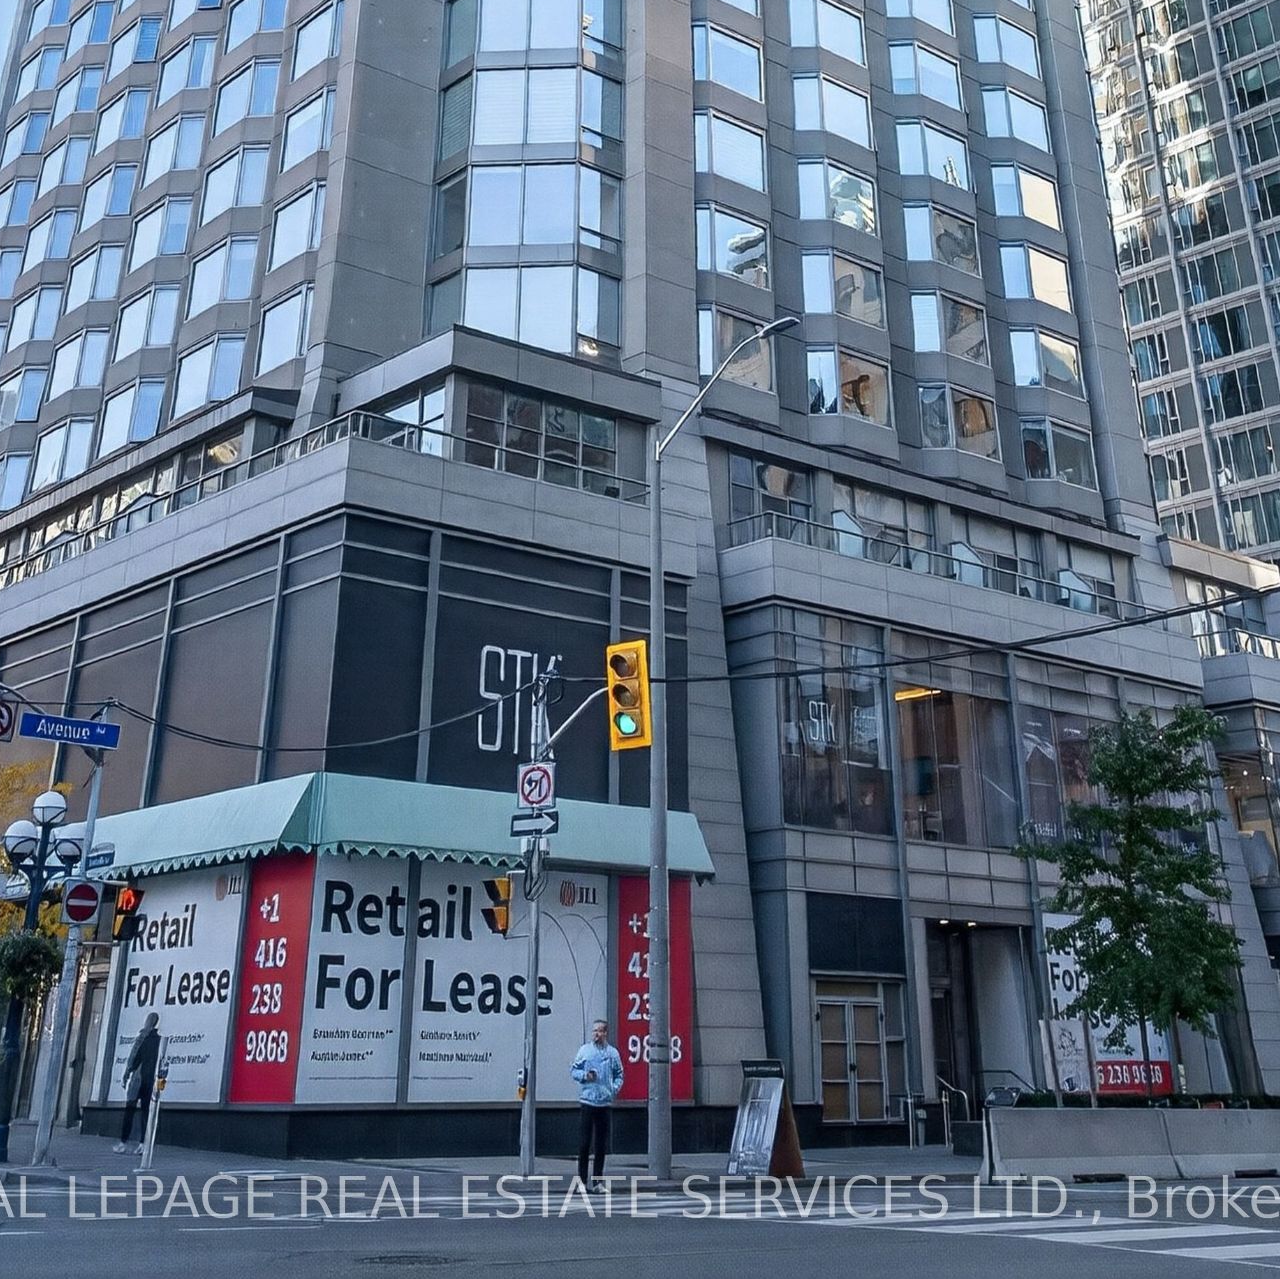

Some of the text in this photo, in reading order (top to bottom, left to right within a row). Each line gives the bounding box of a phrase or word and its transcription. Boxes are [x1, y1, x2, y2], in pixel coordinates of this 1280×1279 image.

[36, 719, 91, 740] Avenue
[808, 700, 837, 742] STK
[259, 893, 280, 922] +1
[321, 879, 473, 941] Retail
[131, 903, 198, 953] Retail
[254, 937, 288, 968] 416
[124, 964, 231, 1008] For Lease
[315, 954, 554, 1016] For Lease
[1049, 961, 1087, 992] For
[249, 983, 284, 1014] 238
[245, 1030, 289, 1063] 9868
